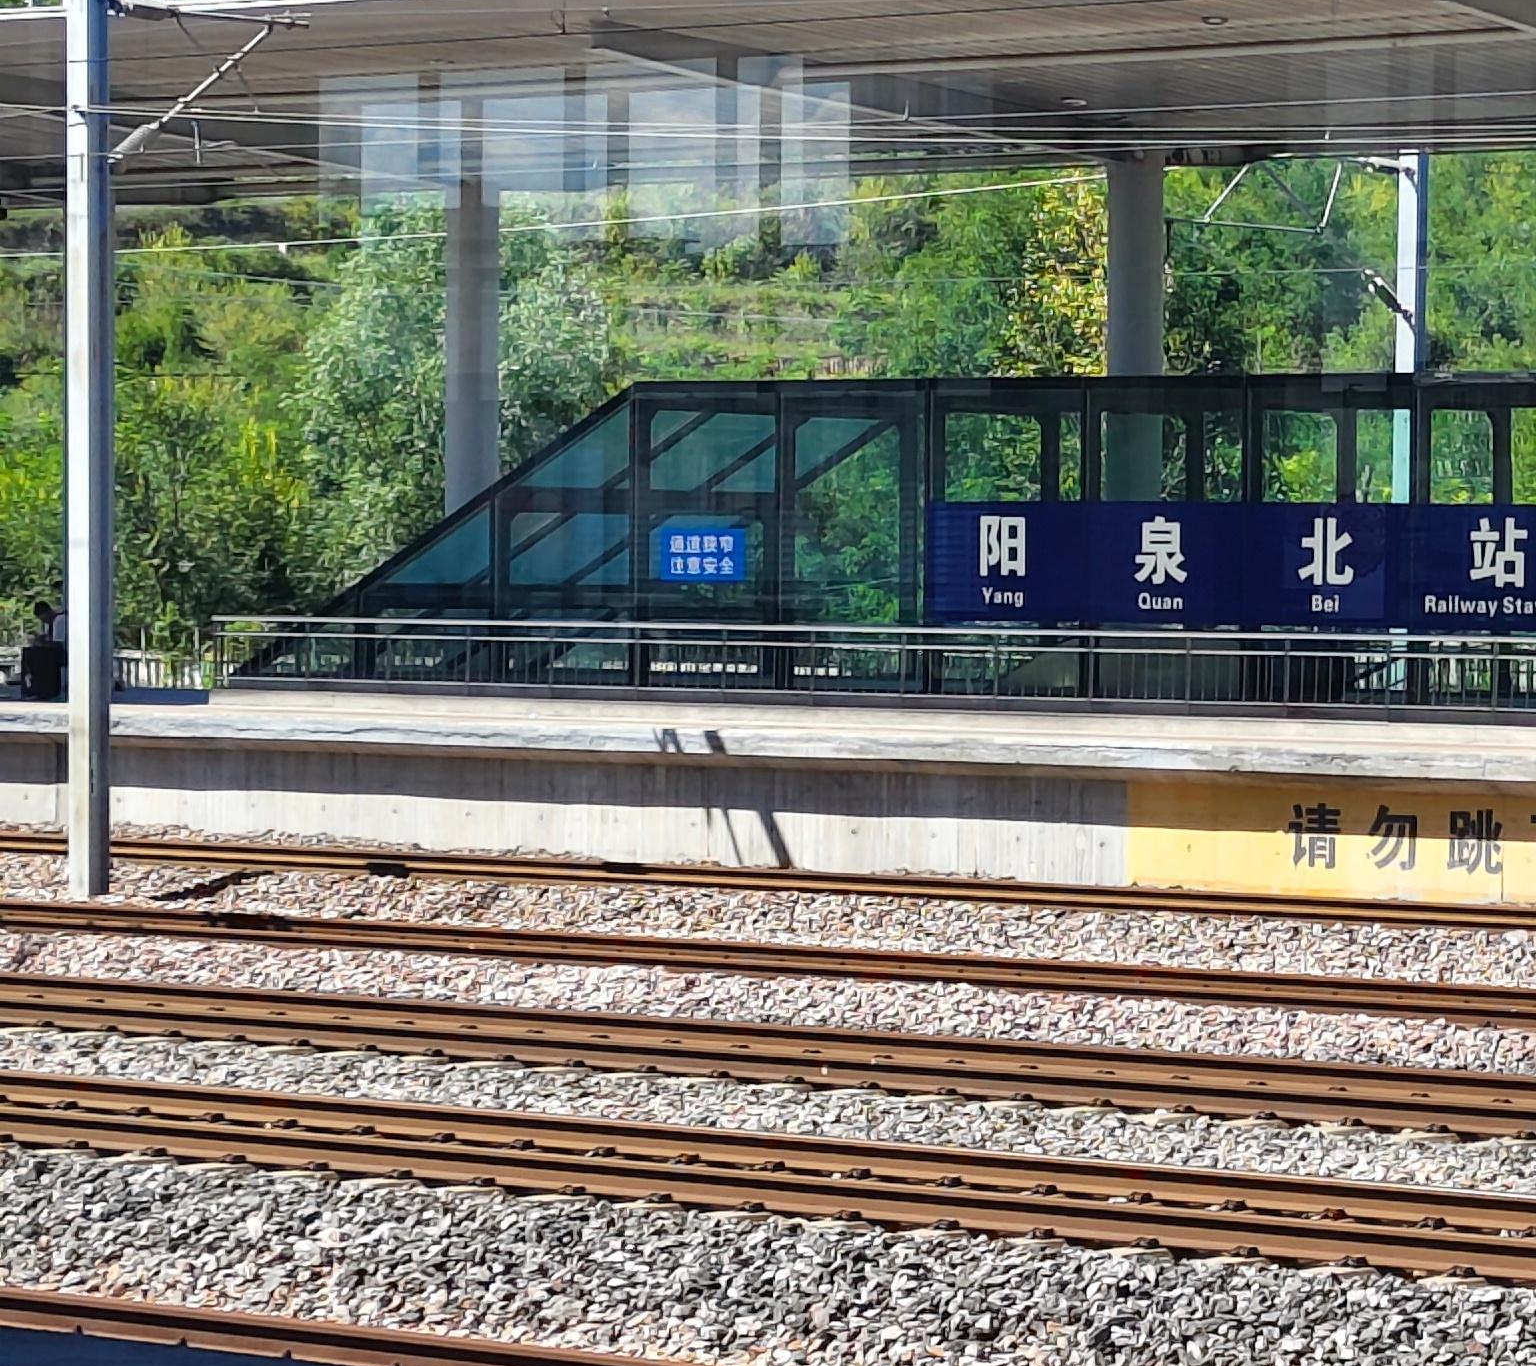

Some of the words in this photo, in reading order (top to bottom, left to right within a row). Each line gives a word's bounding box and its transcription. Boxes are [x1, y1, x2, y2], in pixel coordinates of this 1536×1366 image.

[979, 515, 1528, 588] 阳泉北站
[981, 587, 1024, 608] Yang
[1137, 592, 1184, 610] Quan
[1311, 595, 1339, 614] Bei
[1424, 595, 1498, 618] Railway
